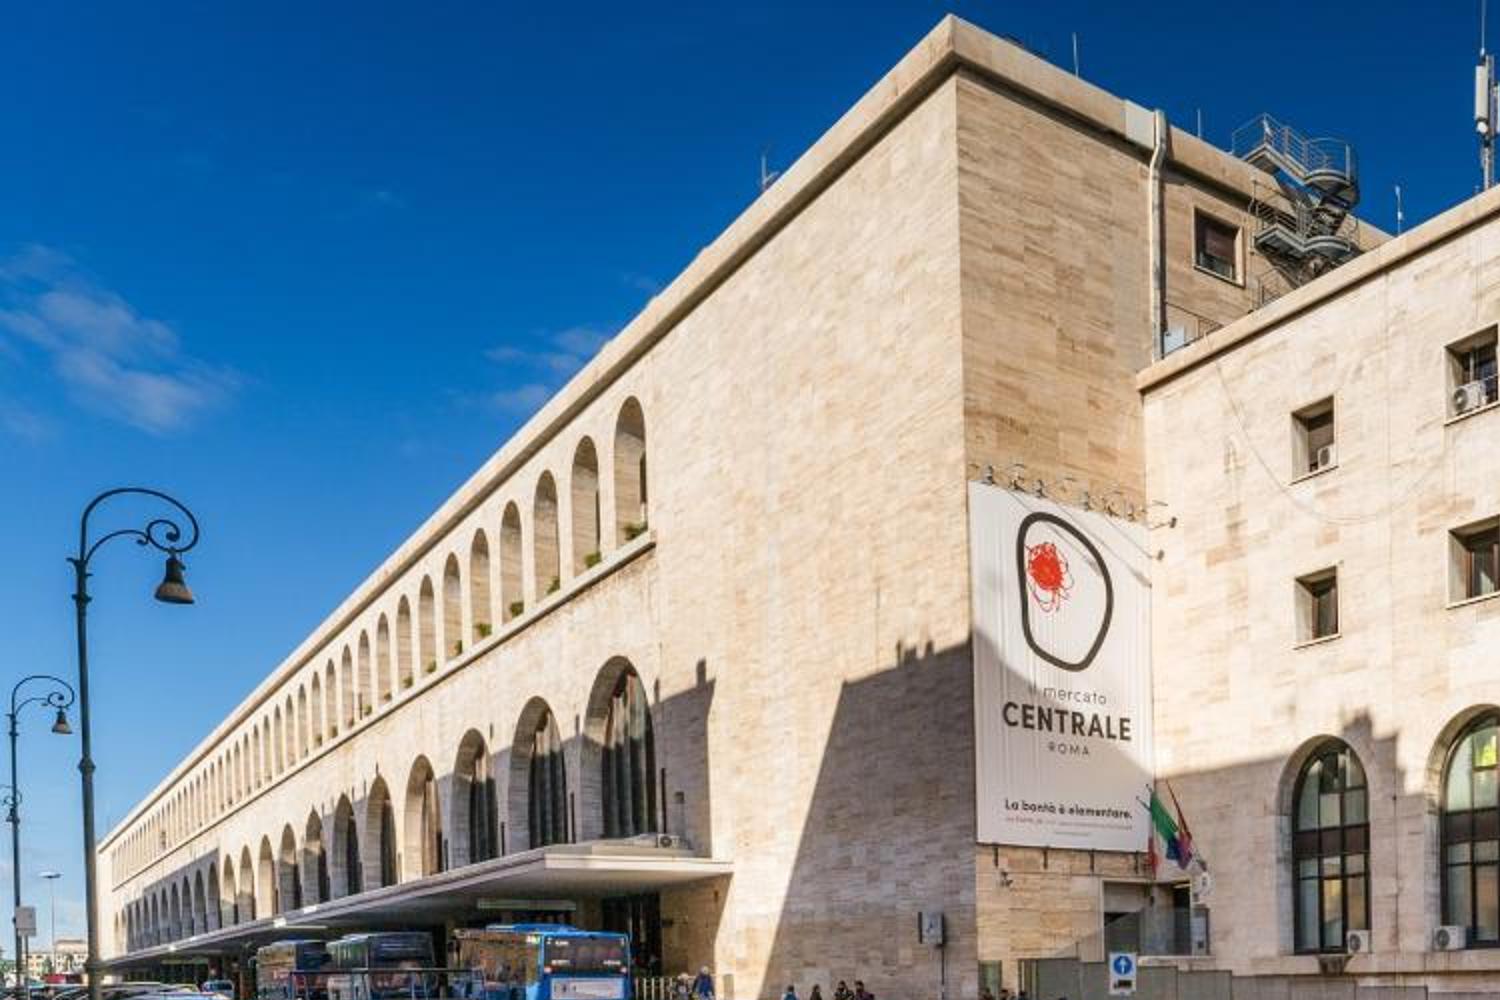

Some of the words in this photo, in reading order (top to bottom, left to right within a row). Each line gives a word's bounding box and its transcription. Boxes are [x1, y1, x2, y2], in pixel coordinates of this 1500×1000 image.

[1043, 687, 1107, 704] mercato
[1002, 701, 1132, 741] CENTRALE
[1048, 741, 1090, 755] ROMA
[1005, 799, 1019, 811] La
